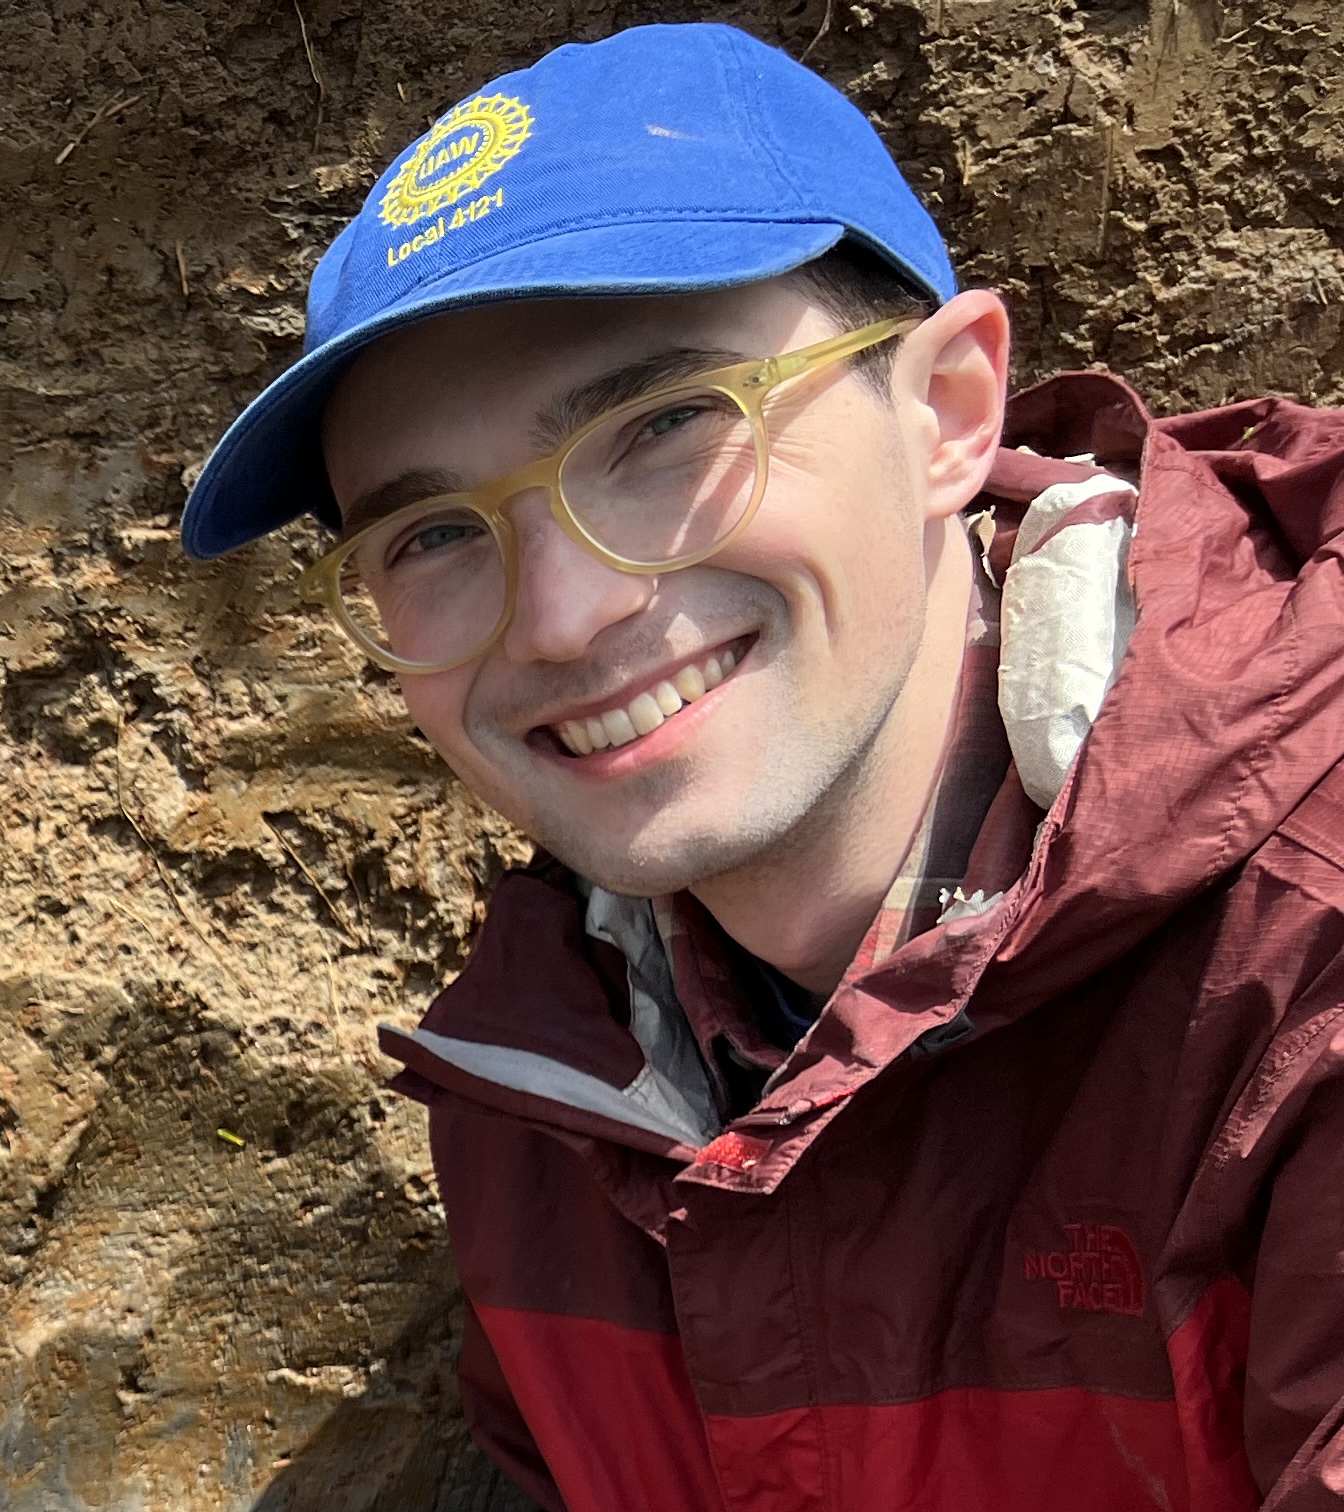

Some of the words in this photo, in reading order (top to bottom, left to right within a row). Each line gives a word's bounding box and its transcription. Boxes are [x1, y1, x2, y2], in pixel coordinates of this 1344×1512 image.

[419, 132, 479, 180] UAW
[387, 217, 445, 267] Local
[448, 187, 504, 230] 4121
[1063, 1223, 1117, 1252] THE
[1056, 1280, 1121, 1311] FACE
